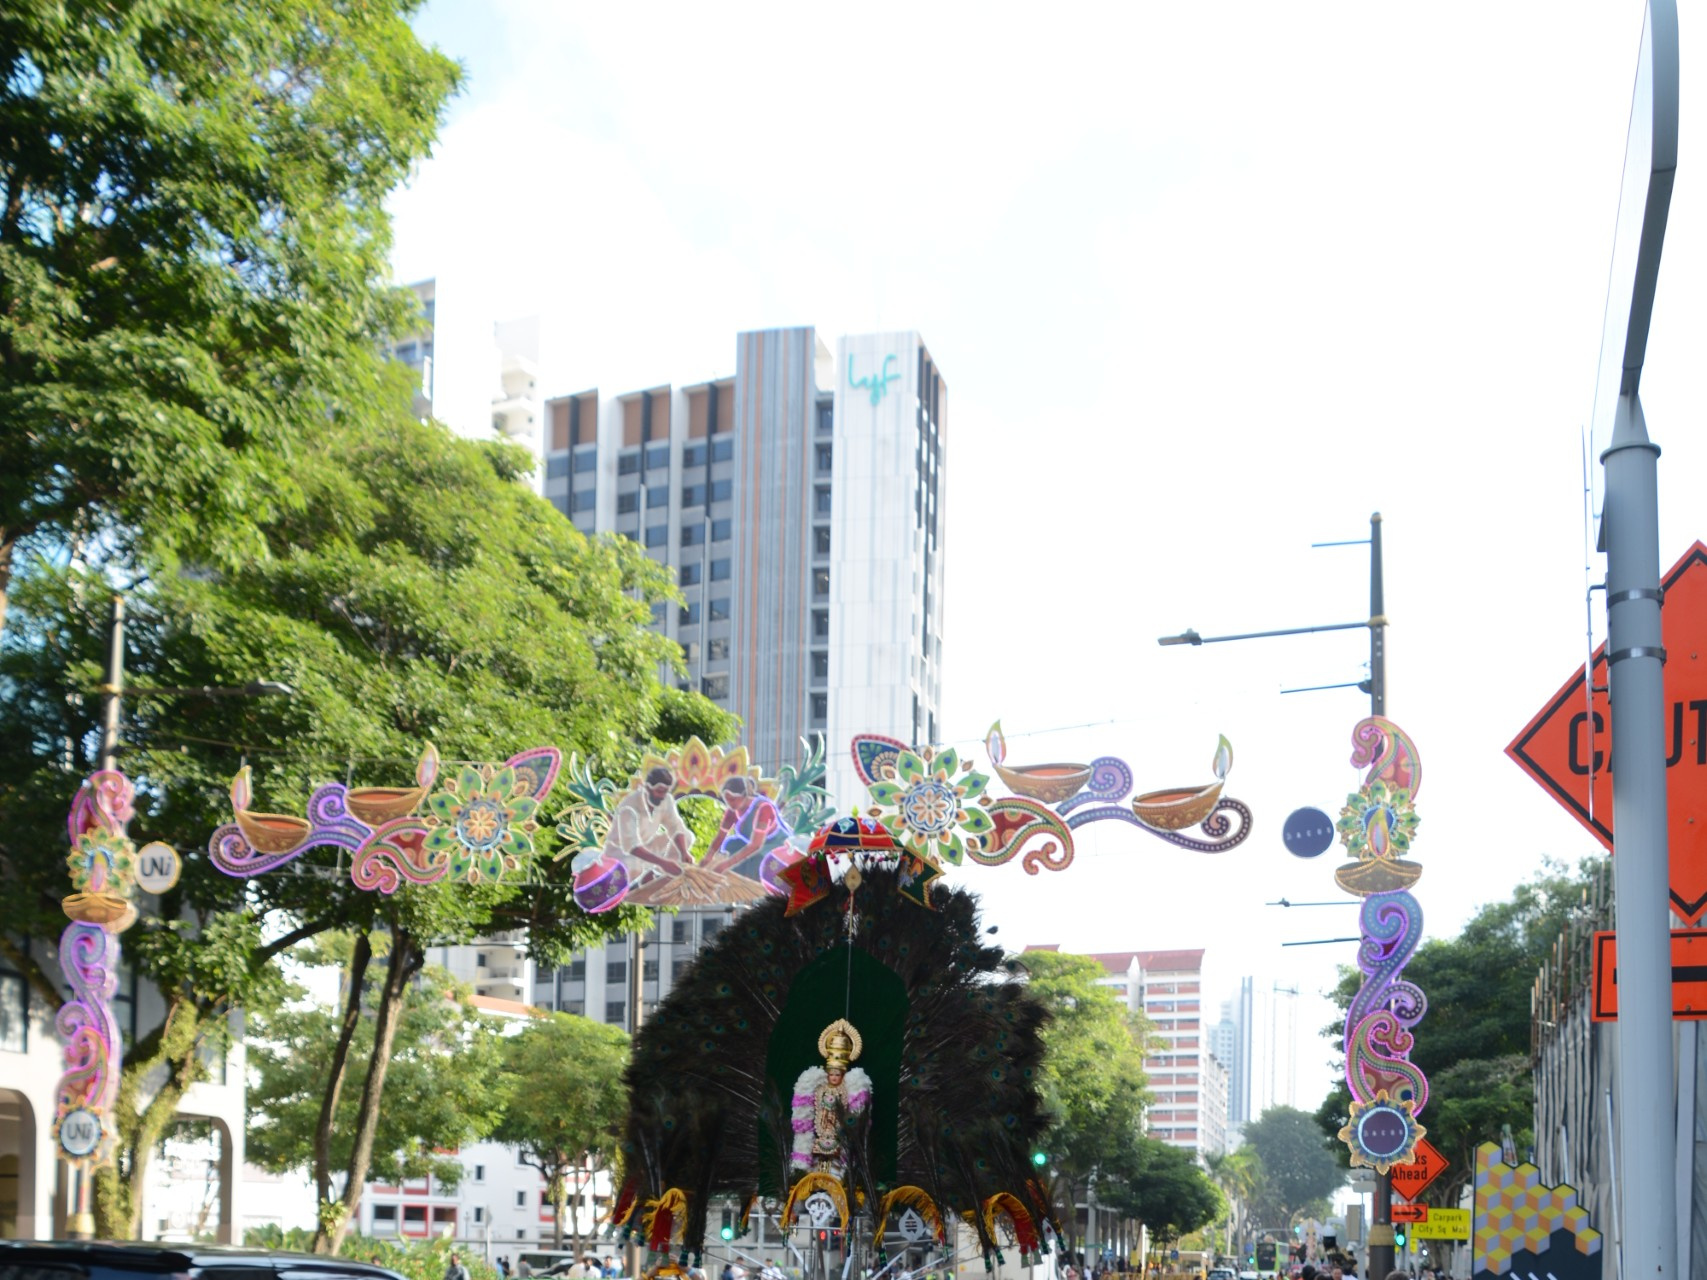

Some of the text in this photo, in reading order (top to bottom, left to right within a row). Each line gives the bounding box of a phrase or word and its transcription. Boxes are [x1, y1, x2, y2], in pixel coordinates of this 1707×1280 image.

[848, 353, 901, 407] lyf
[1392, 1167, 1428, 1180] Ahead
[1433, 1213, 1462, 1223] Carpark
[1418, 1225, 1433, 1235] City
